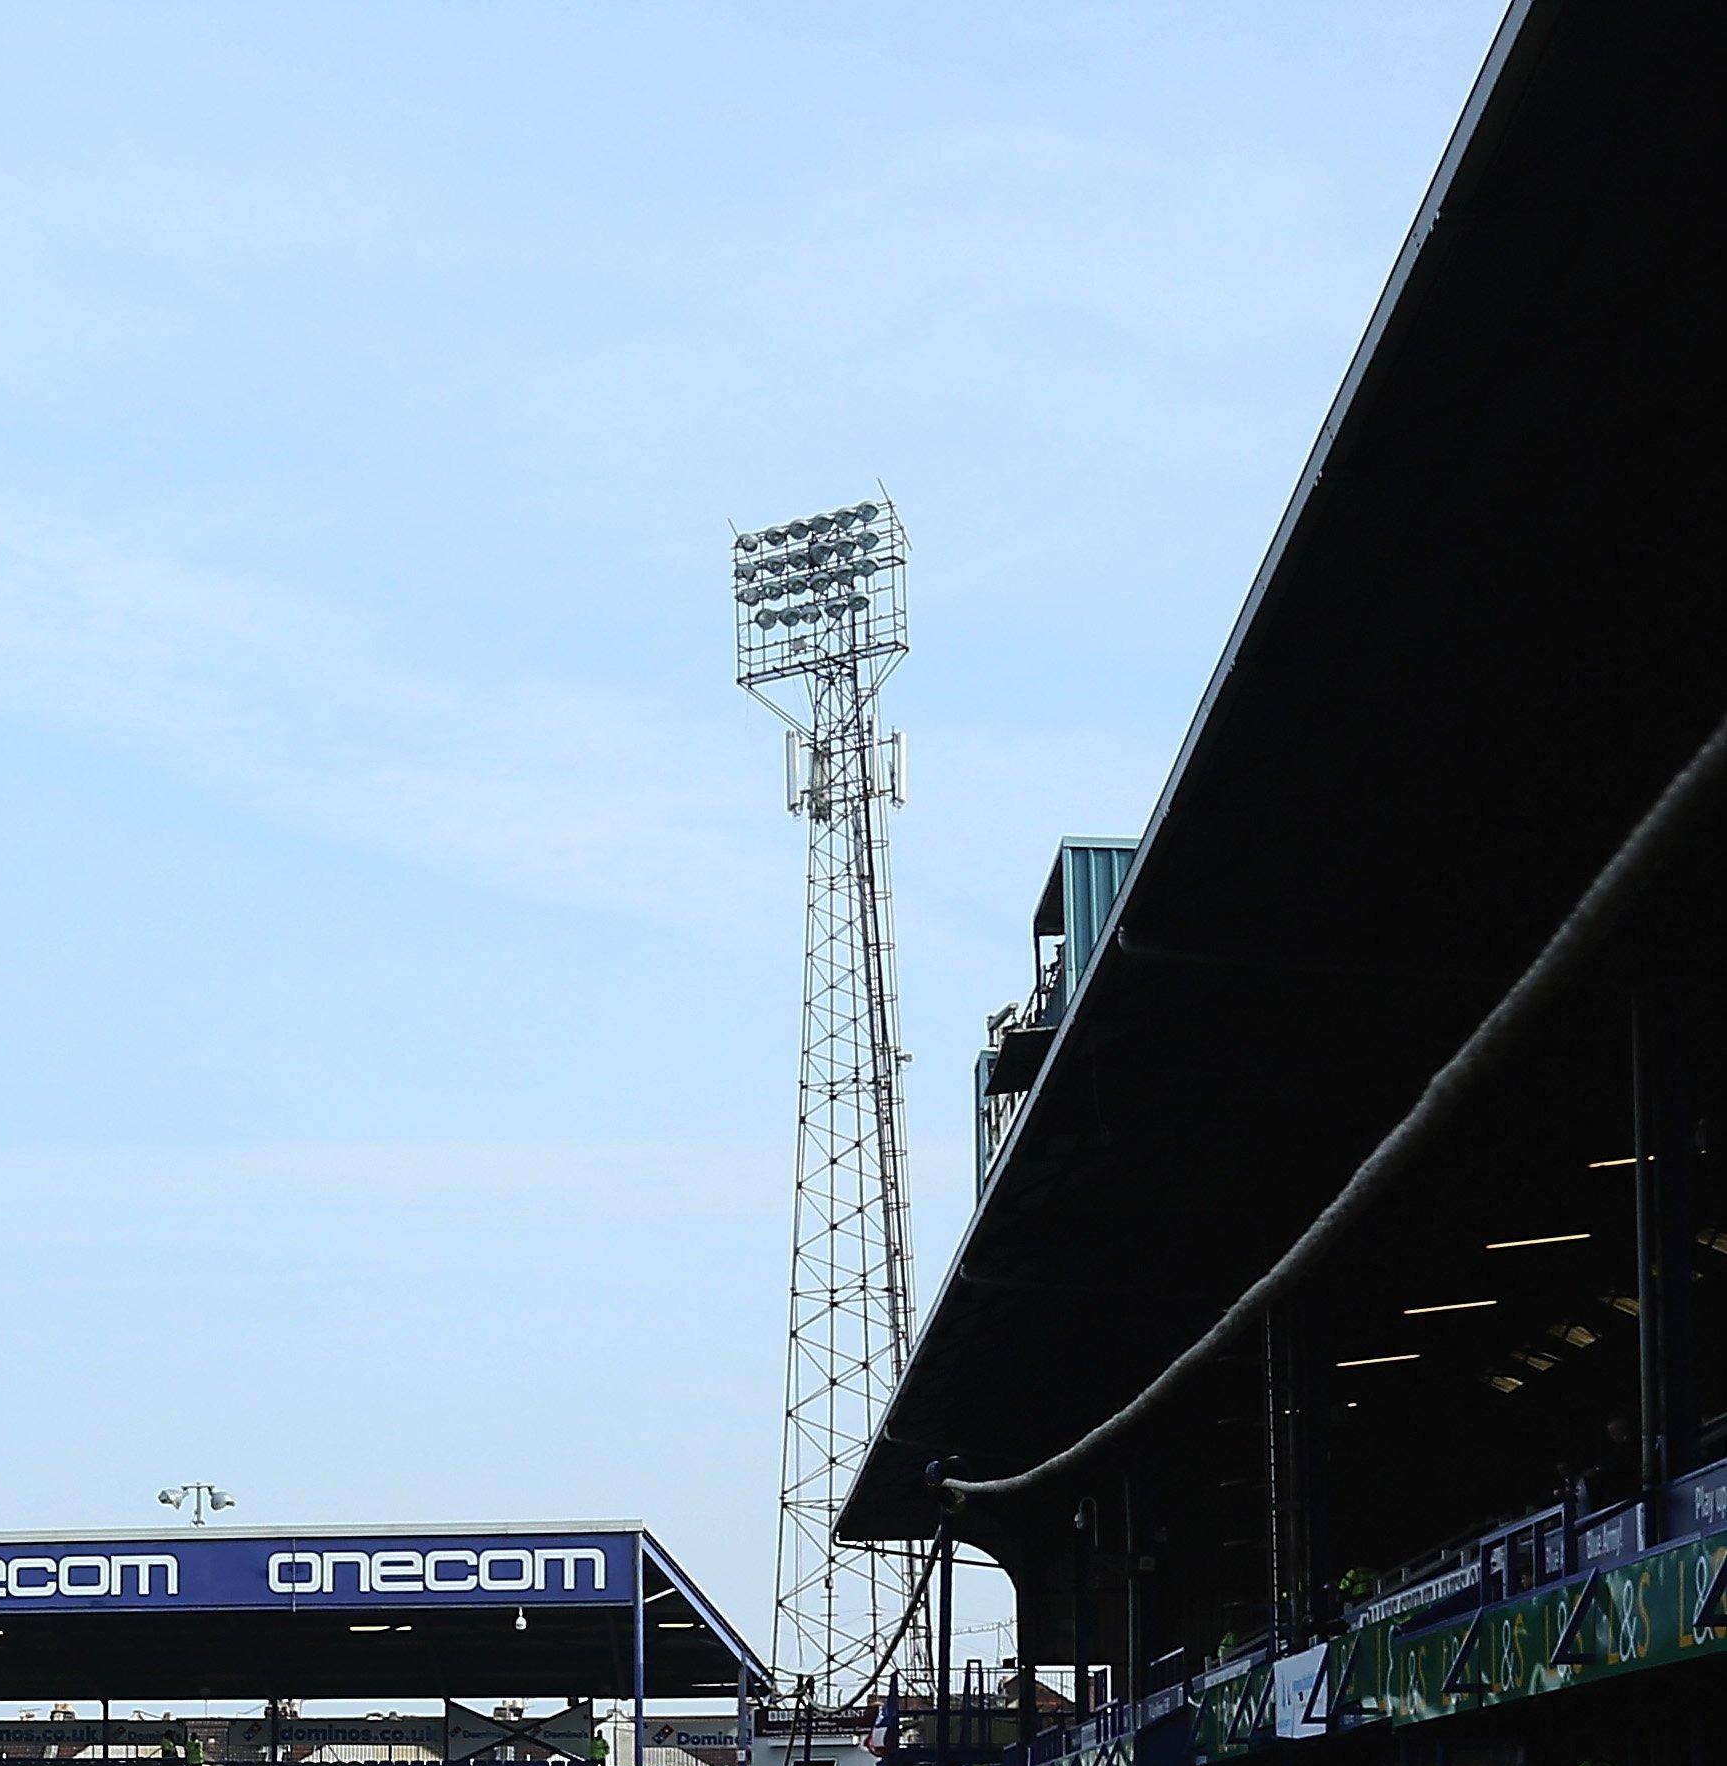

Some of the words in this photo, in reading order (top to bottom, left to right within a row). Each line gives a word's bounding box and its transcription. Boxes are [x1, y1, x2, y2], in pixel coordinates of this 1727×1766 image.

[268, 1548, 606, 1593] onecom
[1607, 1571, 1652, 1665] L&S
[1491, 1612, 1525, 1692] L&S
[677, 1731, 740, 1746] Domin
